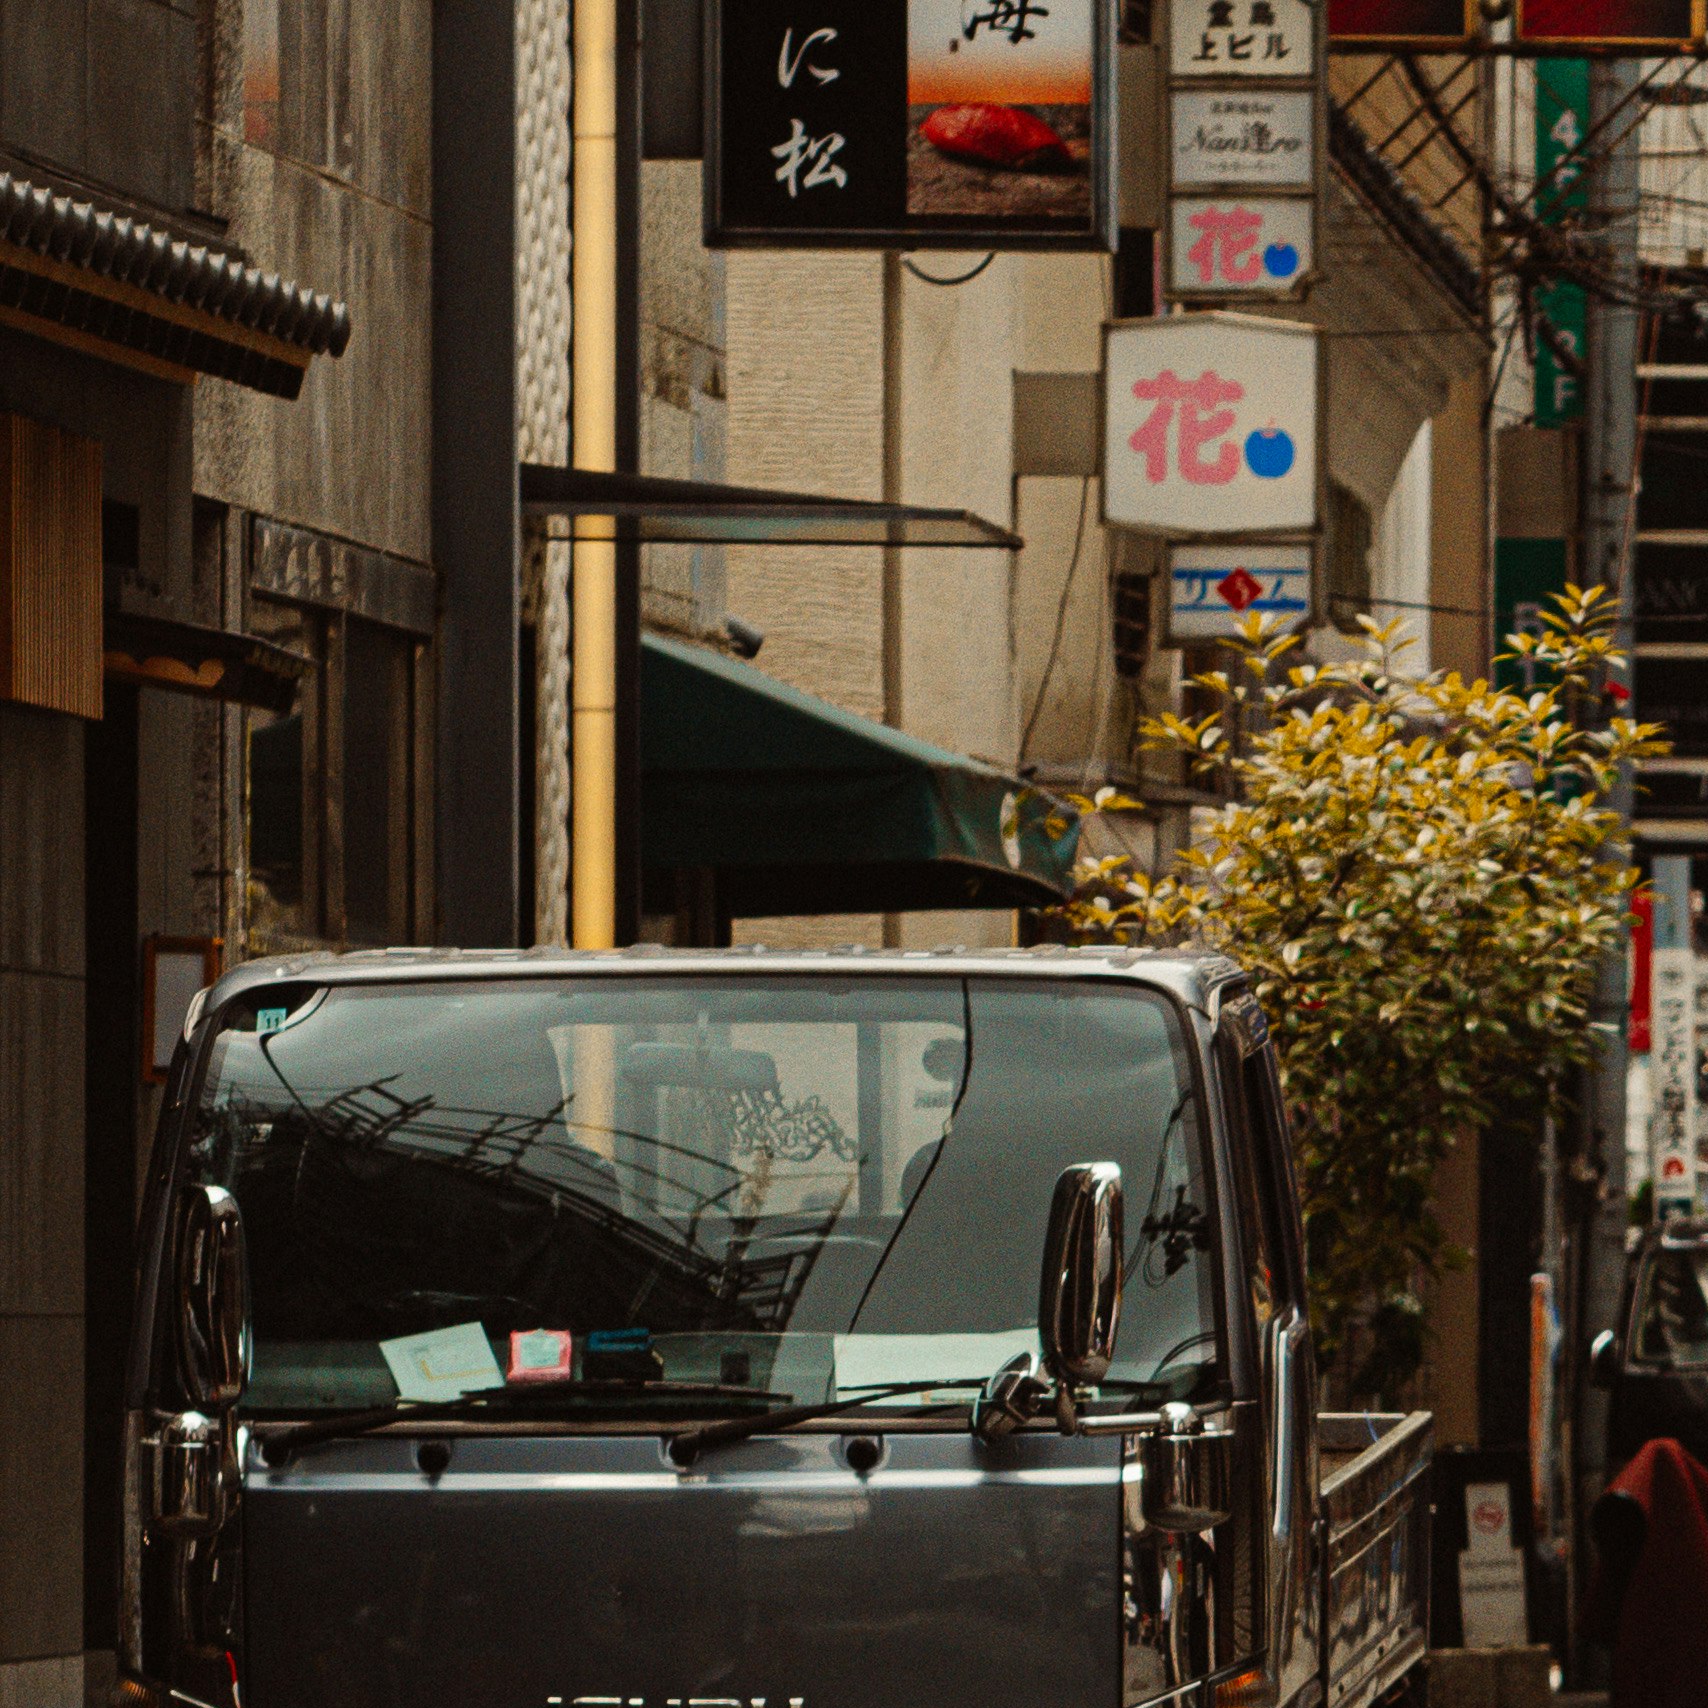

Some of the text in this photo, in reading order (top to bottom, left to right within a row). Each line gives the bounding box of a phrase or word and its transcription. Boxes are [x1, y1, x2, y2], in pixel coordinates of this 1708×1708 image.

[1192, 32, 1292, 61] 上ビル
[1188, 206, 1263, 283] 花
[1129, 368, 1244, 486] 花
